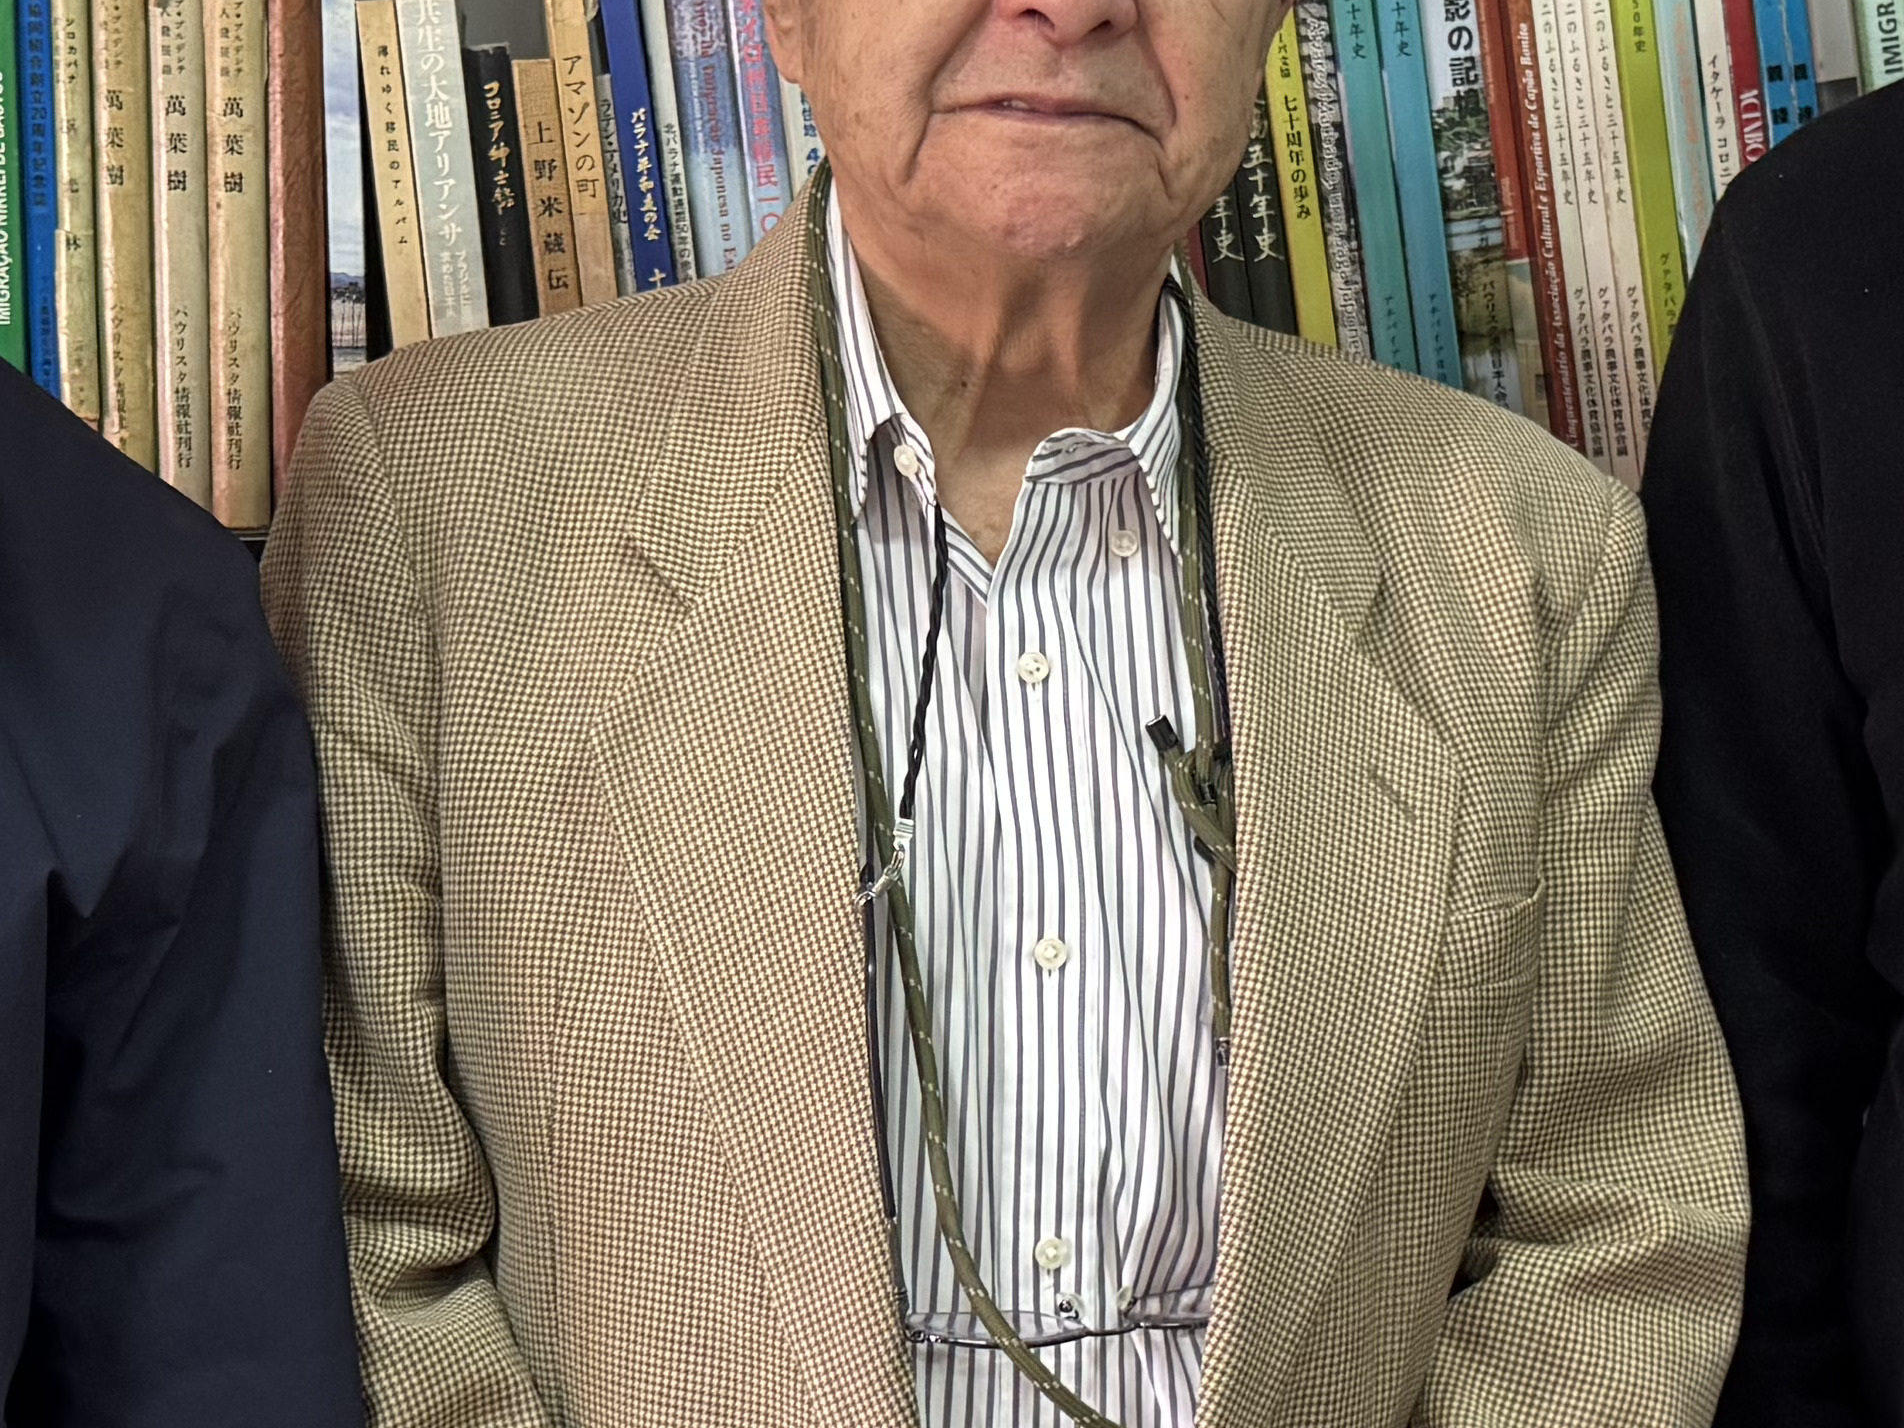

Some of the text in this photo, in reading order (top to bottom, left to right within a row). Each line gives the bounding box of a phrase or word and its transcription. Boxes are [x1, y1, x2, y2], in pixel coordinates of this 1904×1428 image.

[106, 89, 124, 187] 萬葉樹
[164, 95, 187, 191] 萬葉樹
[222, 96, 244, 194] 萬葉樹
[562, 56, 598, 200] アマゾンの町
[227, 307, 243, 470] パウリスタ情報社刊行
